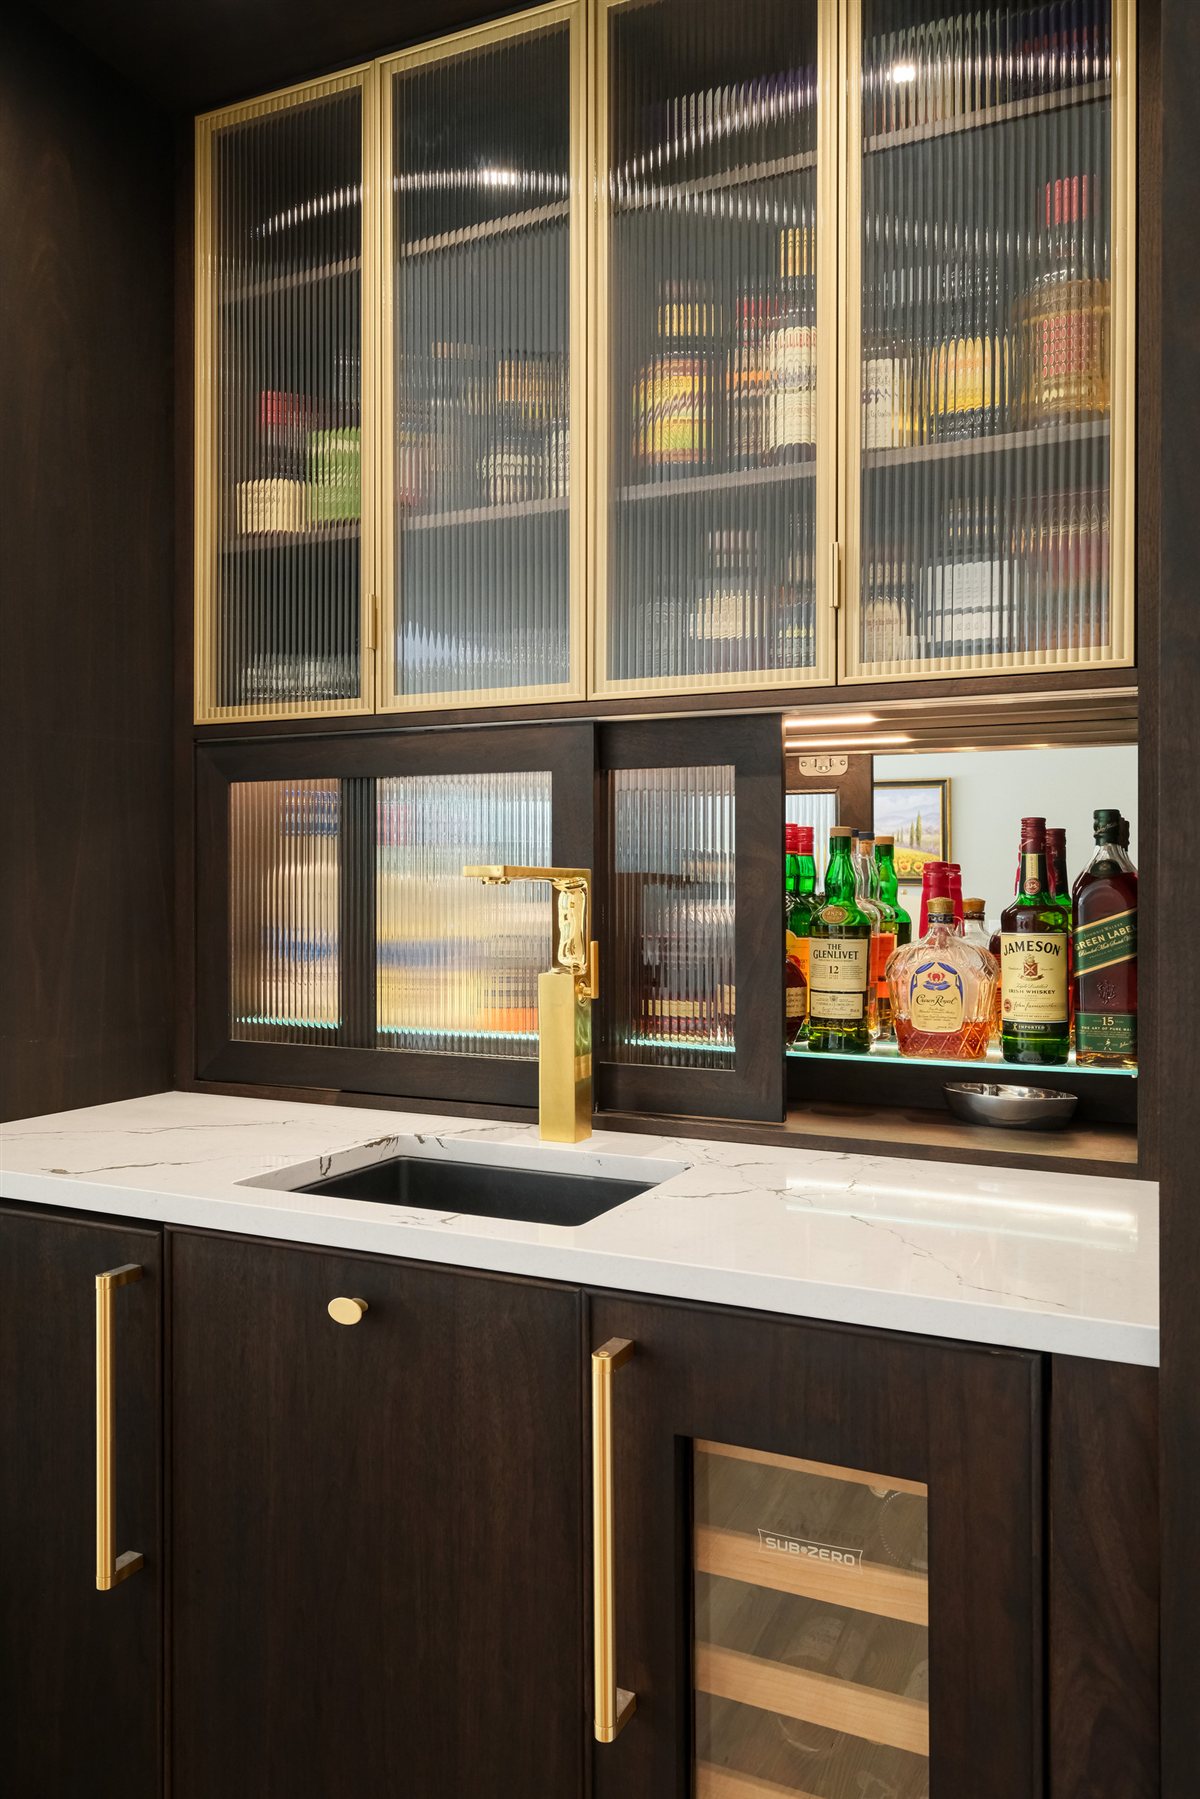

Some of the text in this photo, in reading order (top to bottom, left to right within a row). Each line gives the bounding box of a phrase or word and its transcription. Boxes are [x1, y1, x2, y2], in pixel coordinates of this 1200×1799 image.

[1003, 940, 1062, 956] JAMESON
[1074, 934, 1106, 950] GREEN
[813, 949, 860, 960] GLENLIVET
[828, 965, 840, 975] 12
[915, 994, 958, 1007] Crown Royal
[1101, 1016, 1115, 1026] 15
